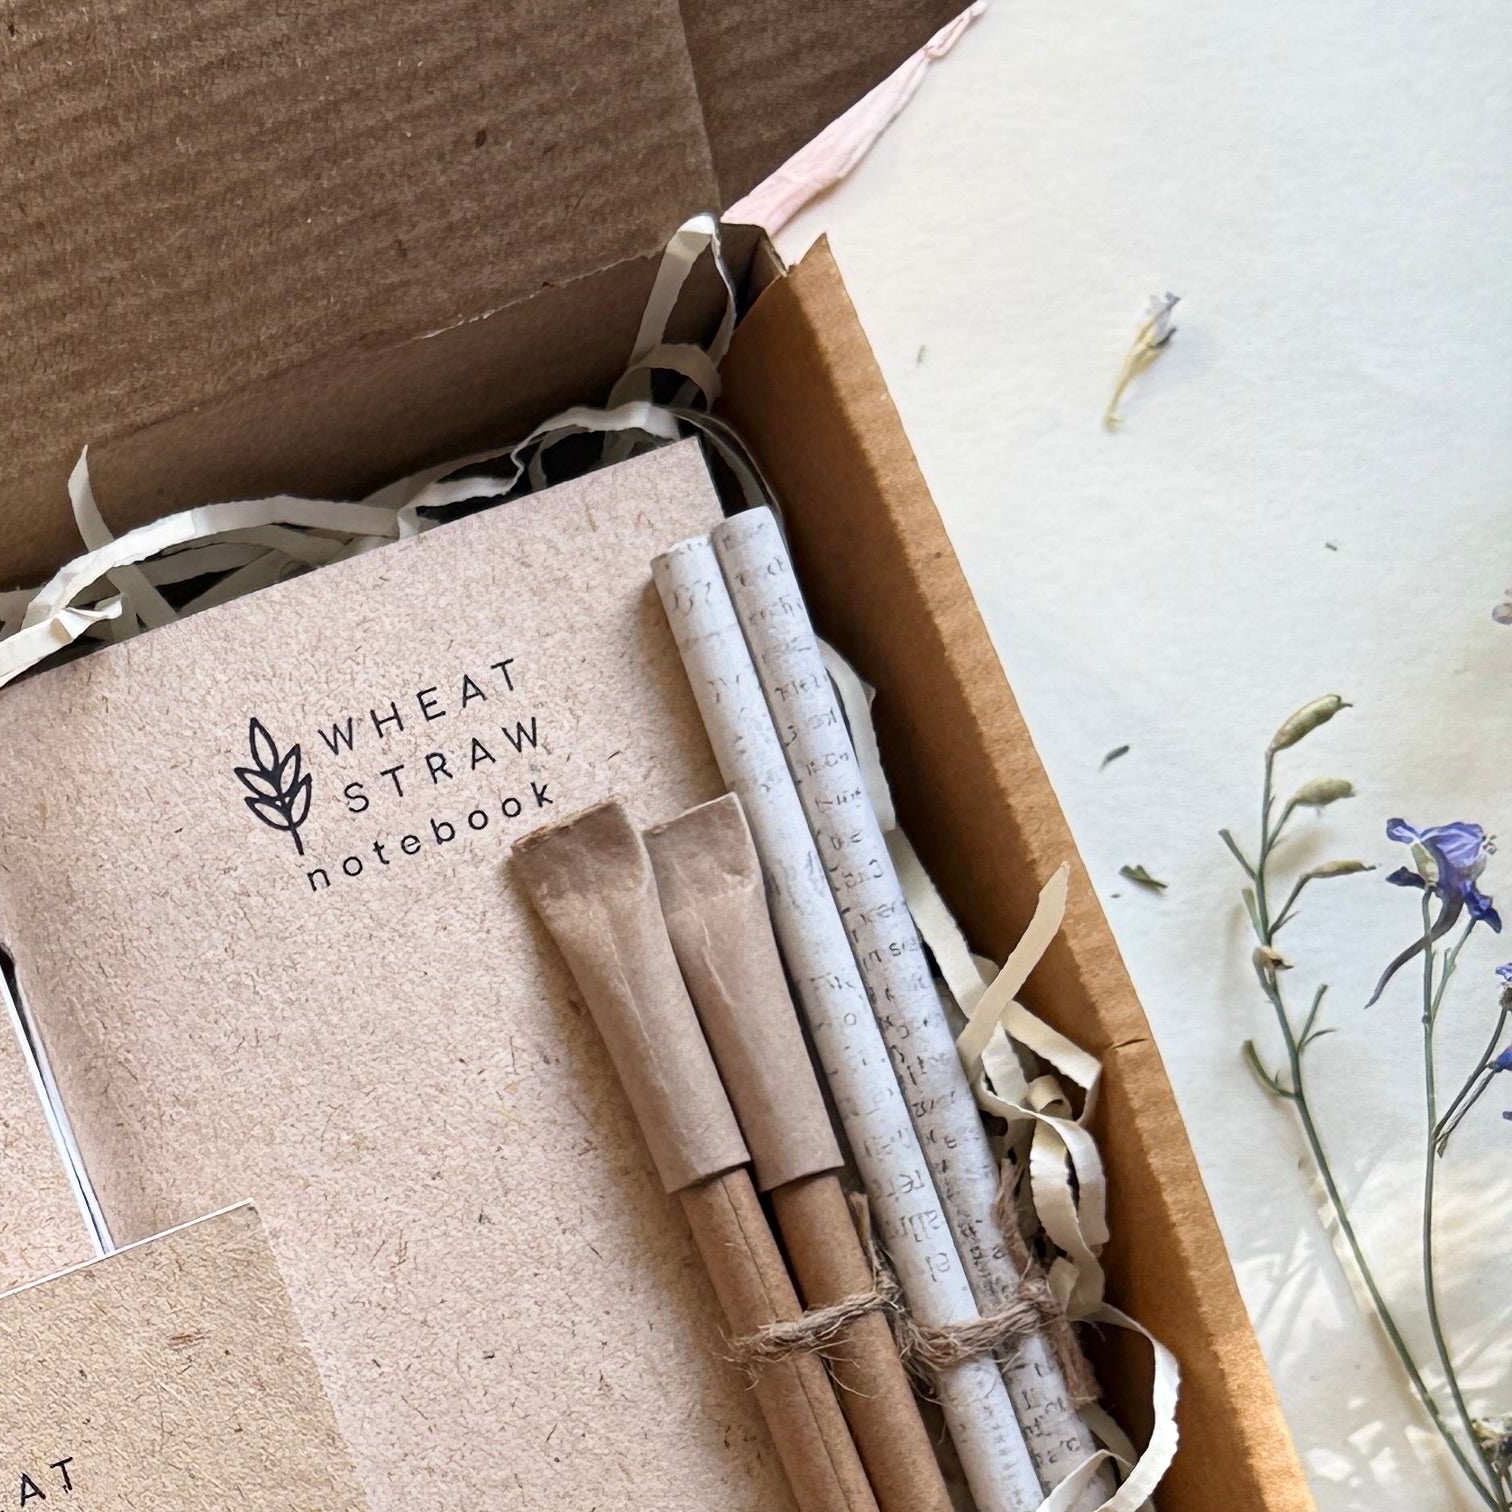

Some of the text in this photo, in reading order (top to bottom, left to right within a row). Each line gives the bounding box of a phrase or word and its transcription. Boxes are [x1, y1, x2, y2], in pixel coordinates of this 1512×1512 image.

[318, 657, 515, 755] WHEAT
[344, 716, 538, 813] STRAW
[307, 781, 554, 892] notebook
